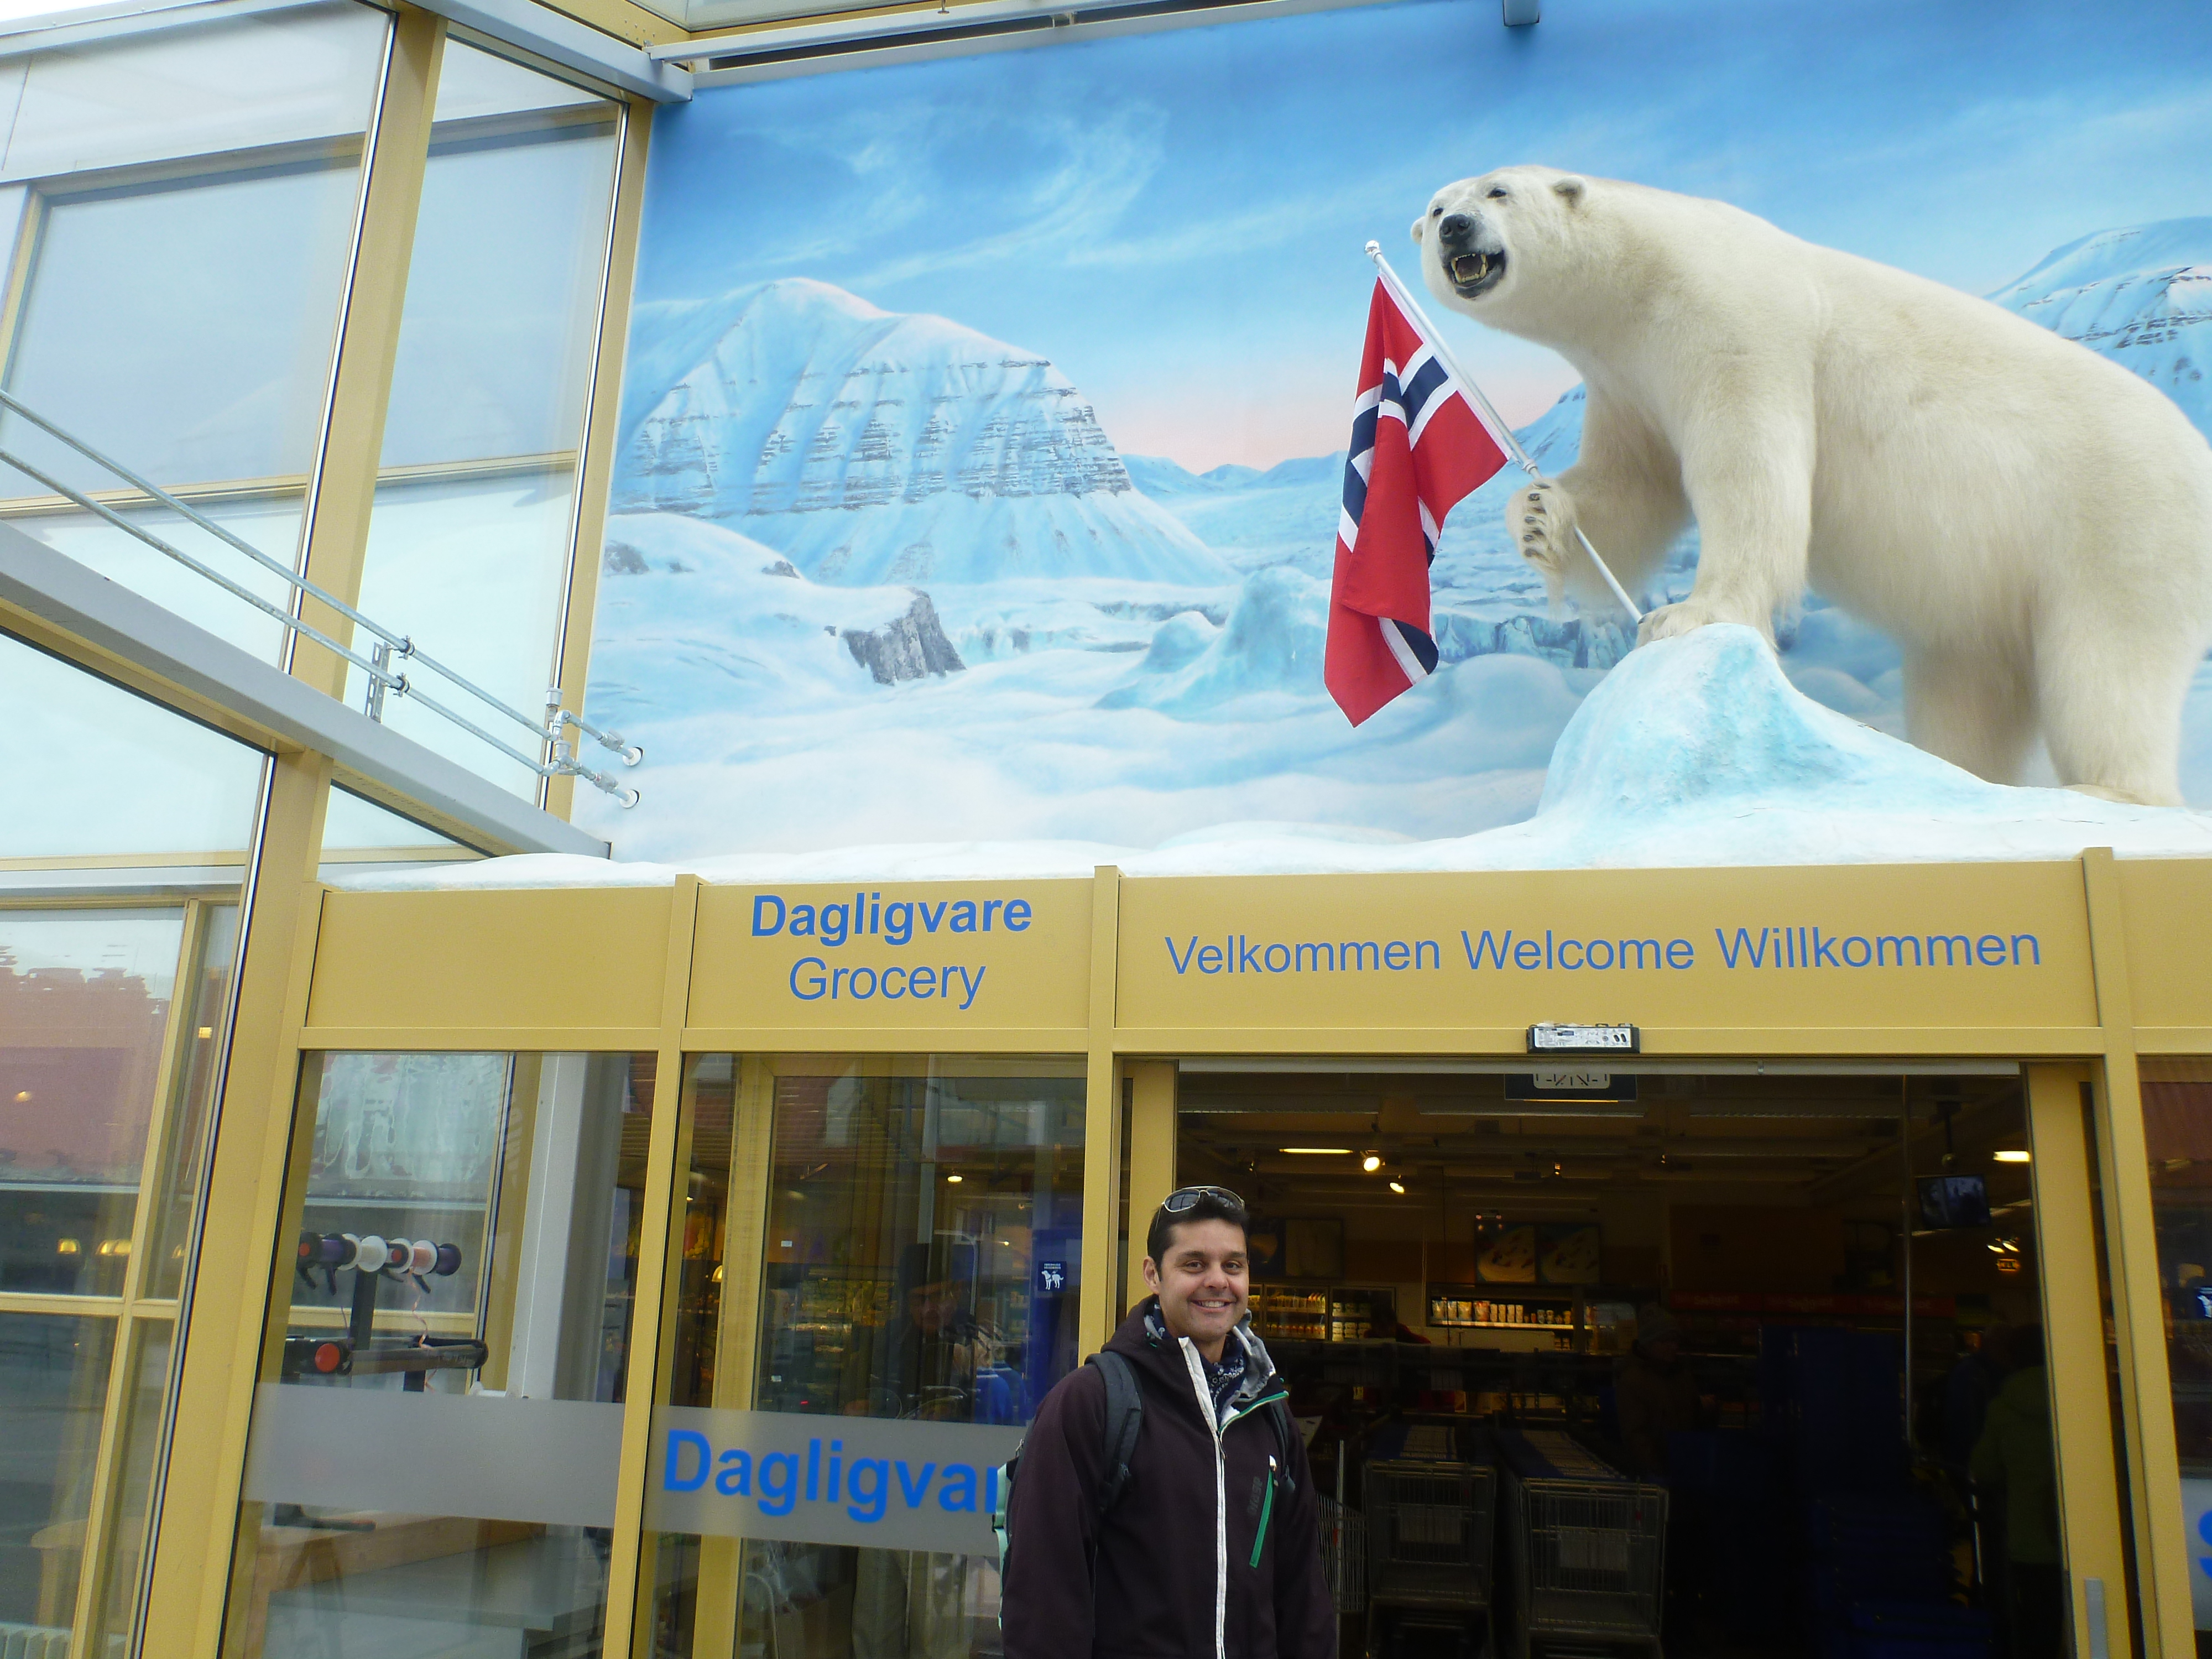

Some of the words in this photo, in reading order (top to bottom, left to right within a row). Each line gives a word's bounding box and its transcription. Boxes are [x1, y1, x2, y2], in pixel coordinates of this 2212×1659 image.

[752, 892, 1032, 946] Dagligvare
[1165, 935, 1439, 974] Velkommen
[1460, 930, 1694, 970] Welcome
[1715, 927, 2040, 968] Willkommen
[789, 957, 986, 1010] Grocery
[664, 1430, 998, 1523] Dagligvar
